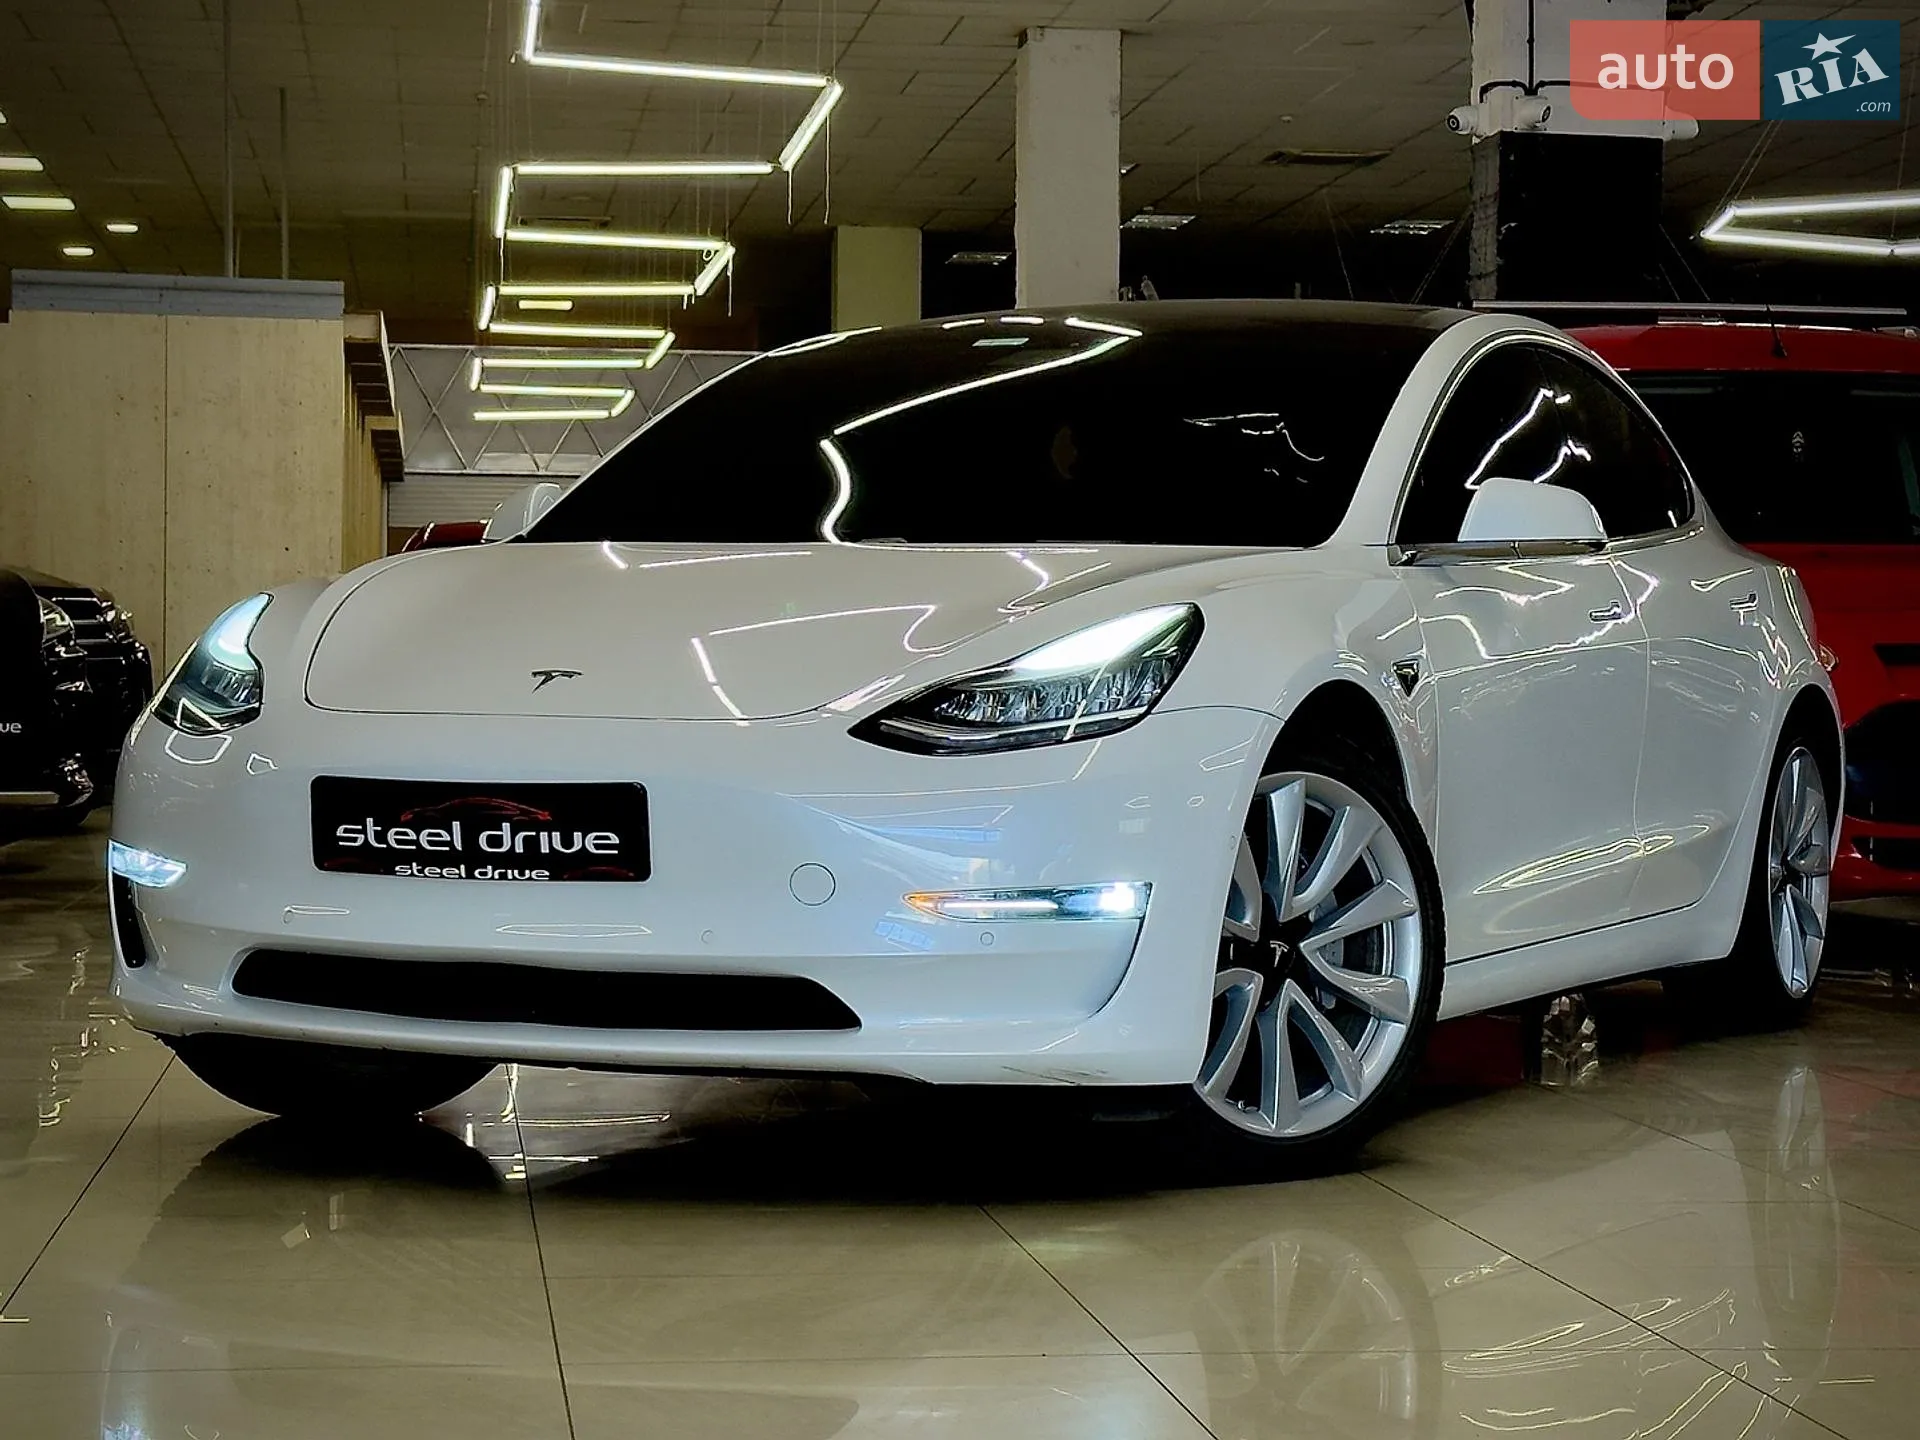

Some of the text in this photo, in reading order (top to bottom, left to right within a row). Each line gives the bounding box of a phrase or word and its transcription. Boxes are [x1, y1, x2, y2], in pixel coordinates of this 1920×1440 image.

[336, 817, 620, 854] steel drive
[394, 862, 550, 880] steel drive
